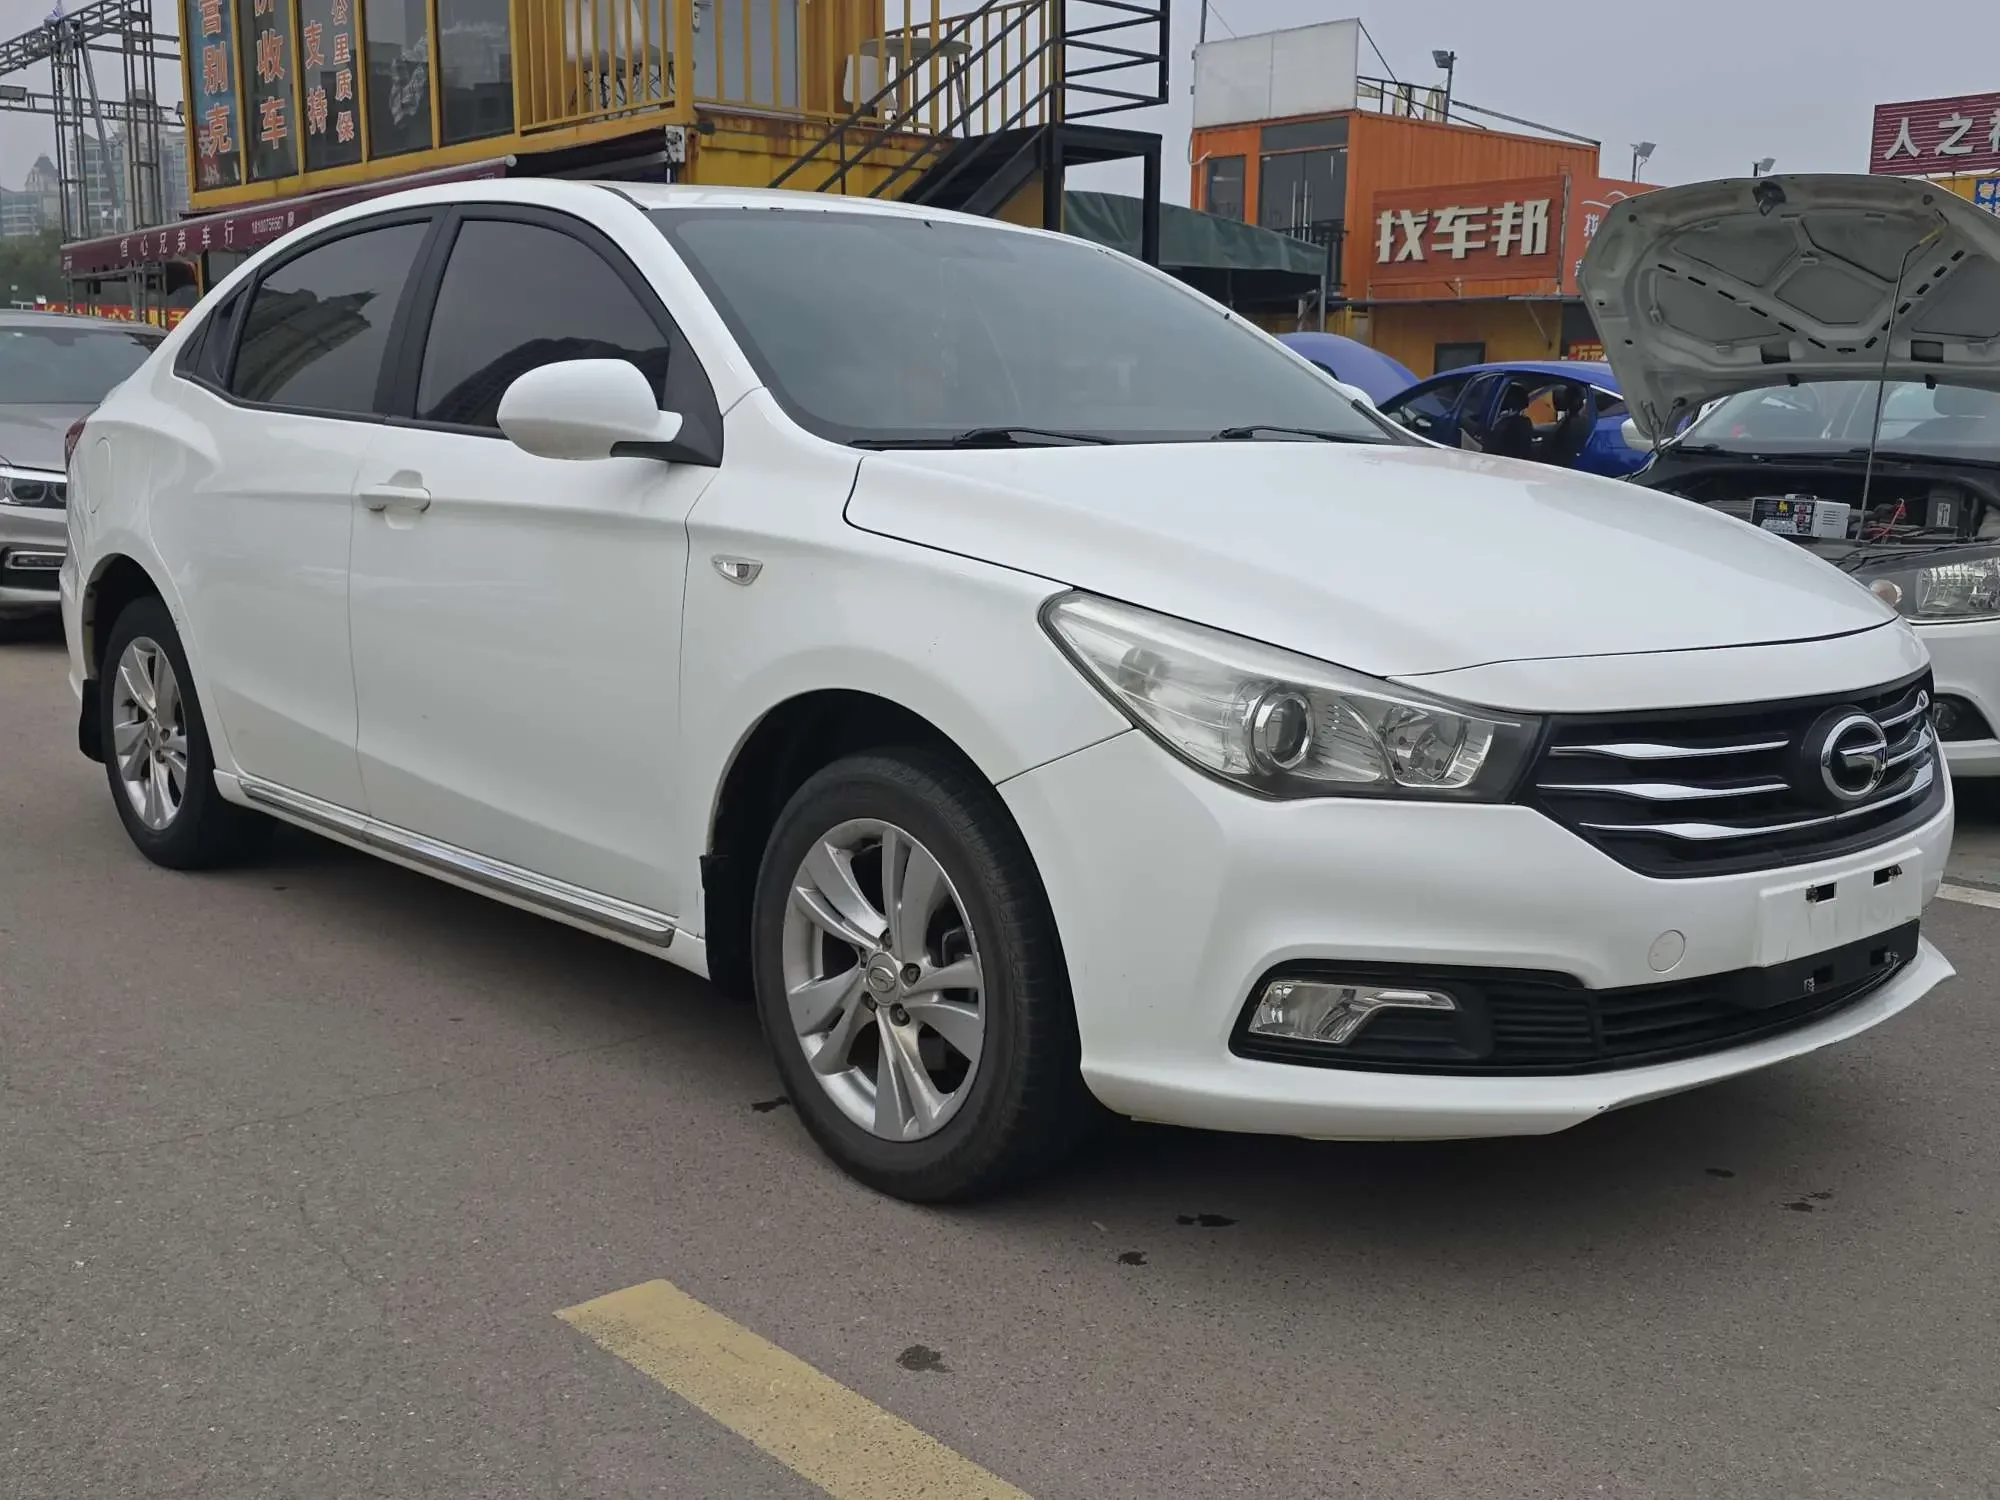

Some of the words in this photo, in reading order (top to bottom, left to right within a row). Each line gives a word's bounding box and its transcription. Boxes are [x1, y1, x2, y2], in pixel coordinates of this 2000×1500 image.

[303, 19, 328, 135] 支持
[331, 0, 355, 143] 公里质保
[1376, 199, 1549, 263] 找车邦
